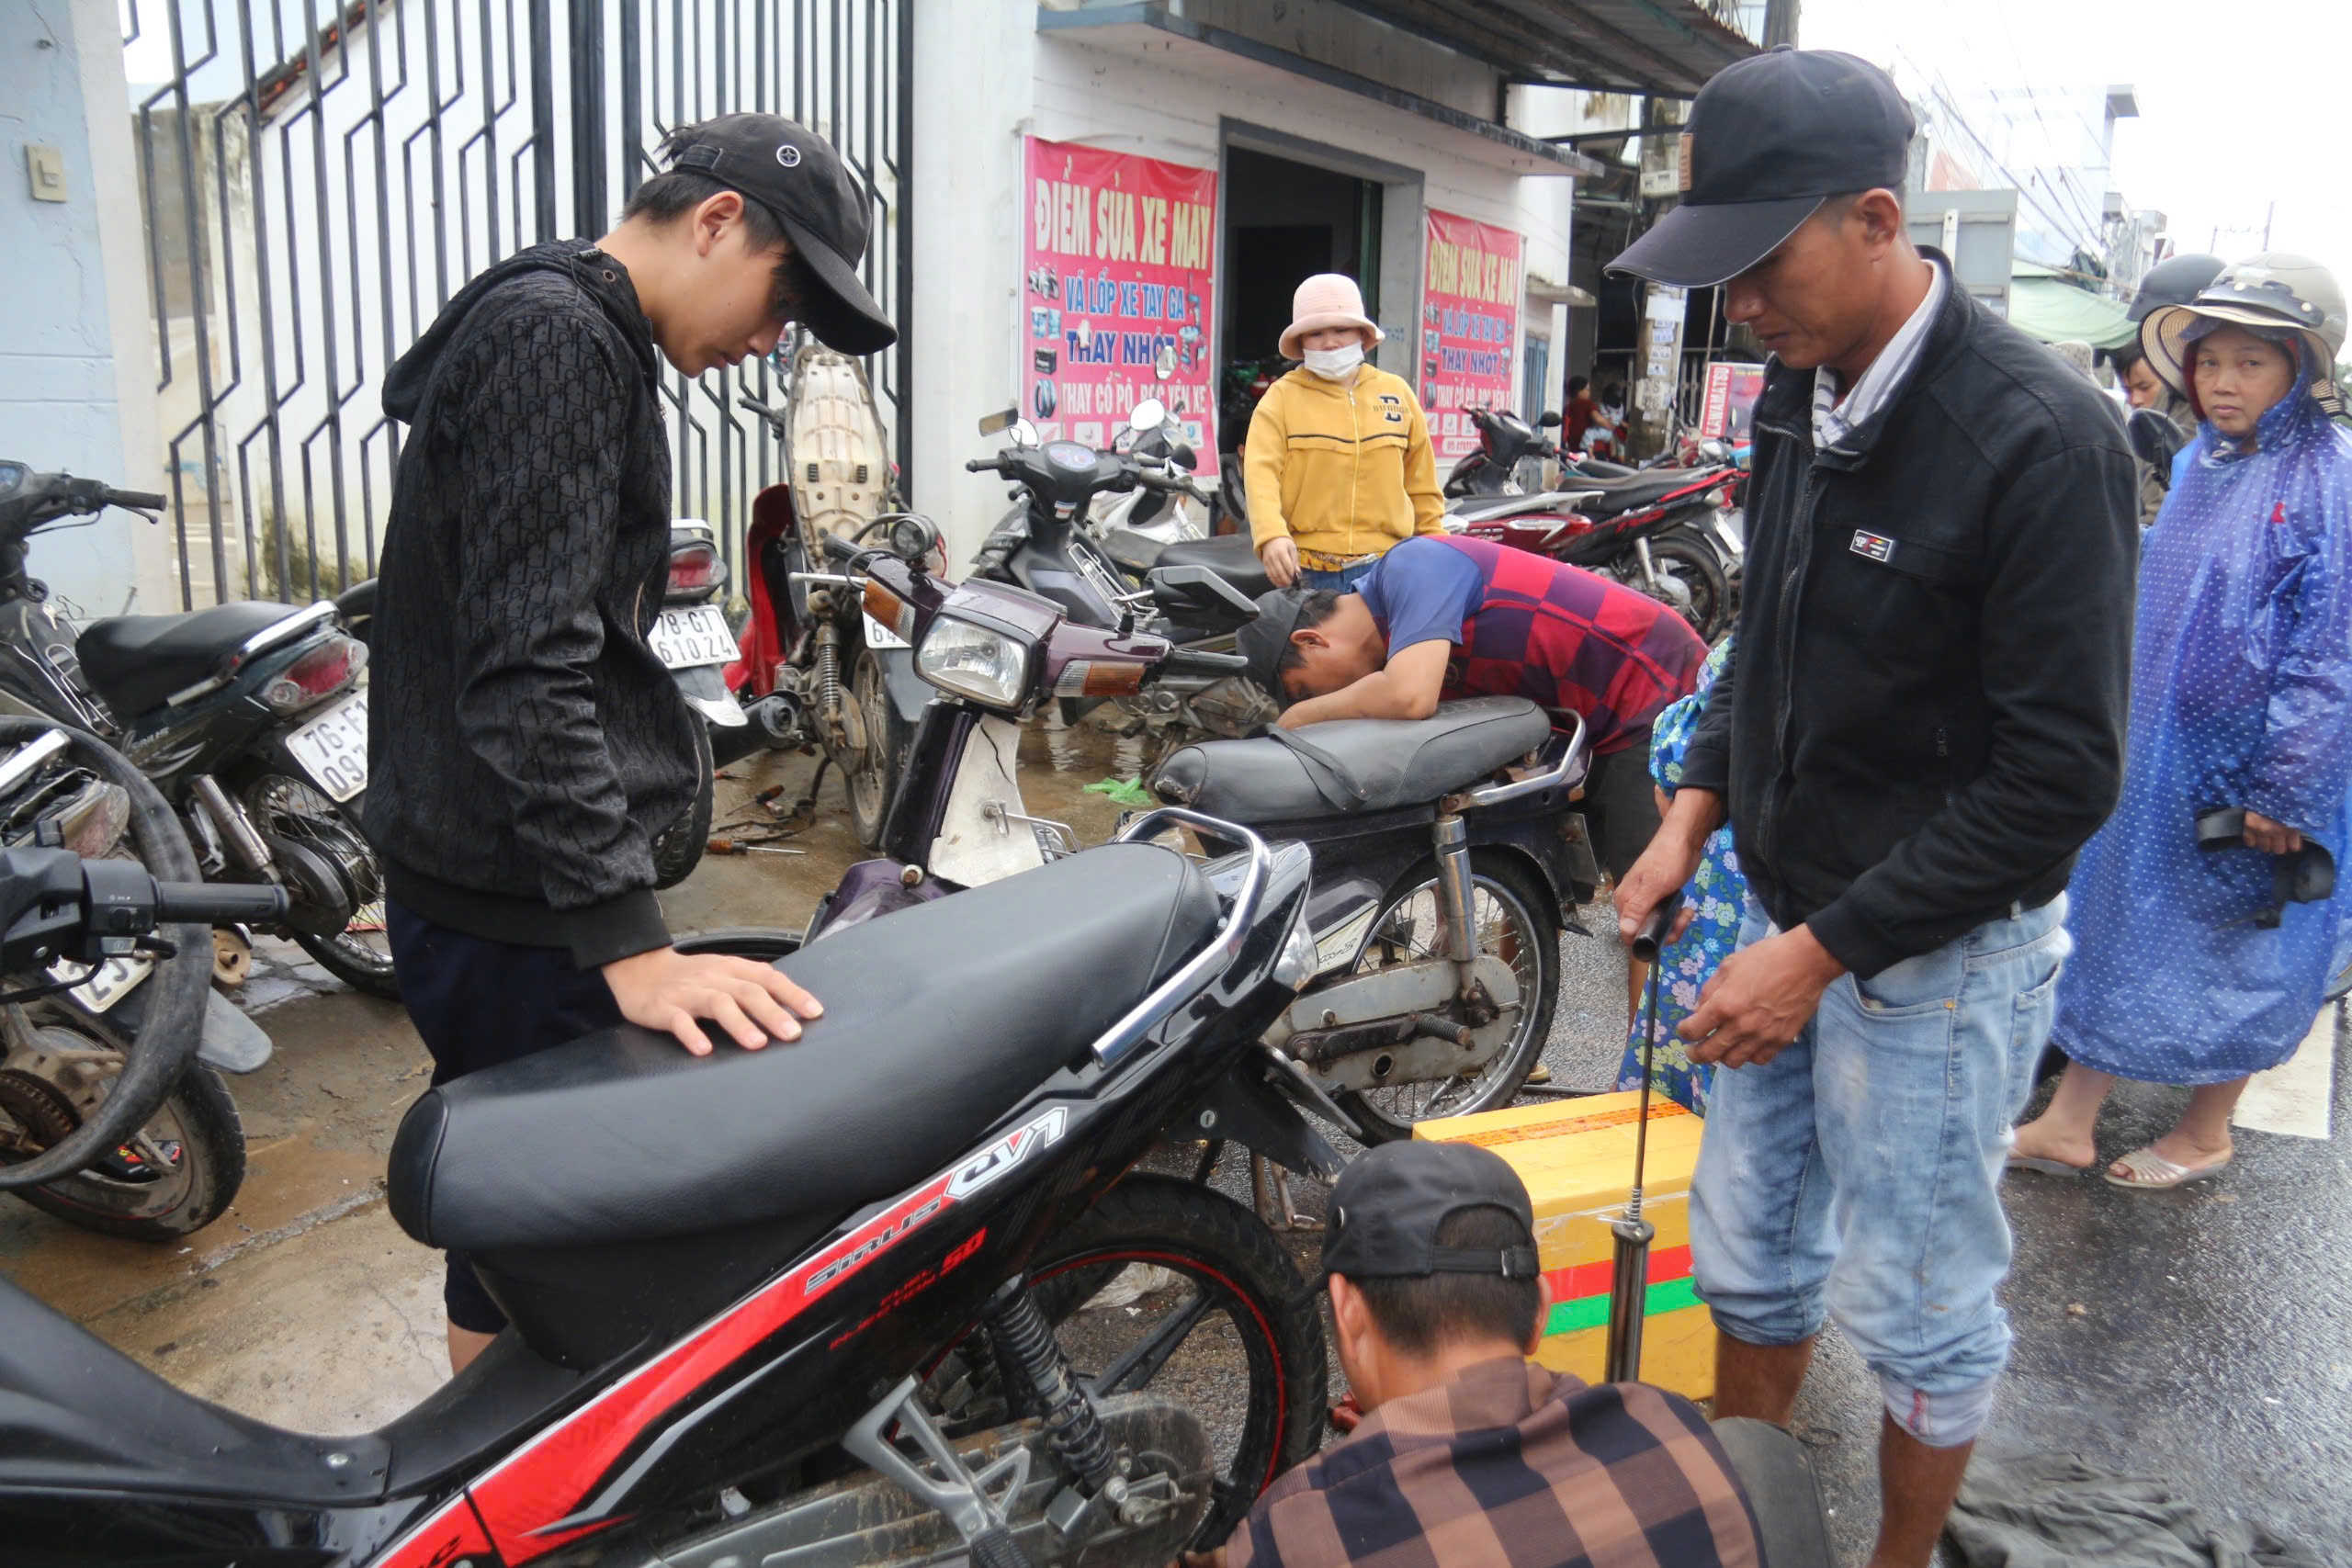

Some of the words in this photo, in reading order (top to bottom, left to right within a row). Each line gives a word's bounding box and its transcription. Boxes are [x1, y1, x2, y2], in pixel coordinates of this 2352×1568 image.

[1035, 154, 1091, 256] ĐIỂM
[1095, 169, 1136, 261] SỬA
[1139, 195, 1167, 265] XE
[1170, 190, 1211, 270] MÁY
[1066, 269, 1085, 313] VÁ
[1089, 267, 1116, 316] LỐP
[1119, 281, 1138, 317] XE
[1141, 283, 1165, 319] TAY
[1167, 287, 1185, 321] GA
[1483, 253, 1498, 302] XE
[1066, 328, 1117, 364] THAY
[1442, 345, 1468, 372] THAY
[1061, 382, 1091, 414] THAY
[1095, 371, 1113, 414] CỔ
[1116, 377, 1134, 414] PÔ
[1193, 385, 1207, 414] XE
[1706, 367, 1730, 435] KAWAMATSU
[657, 635, 733, 663] 610.24
